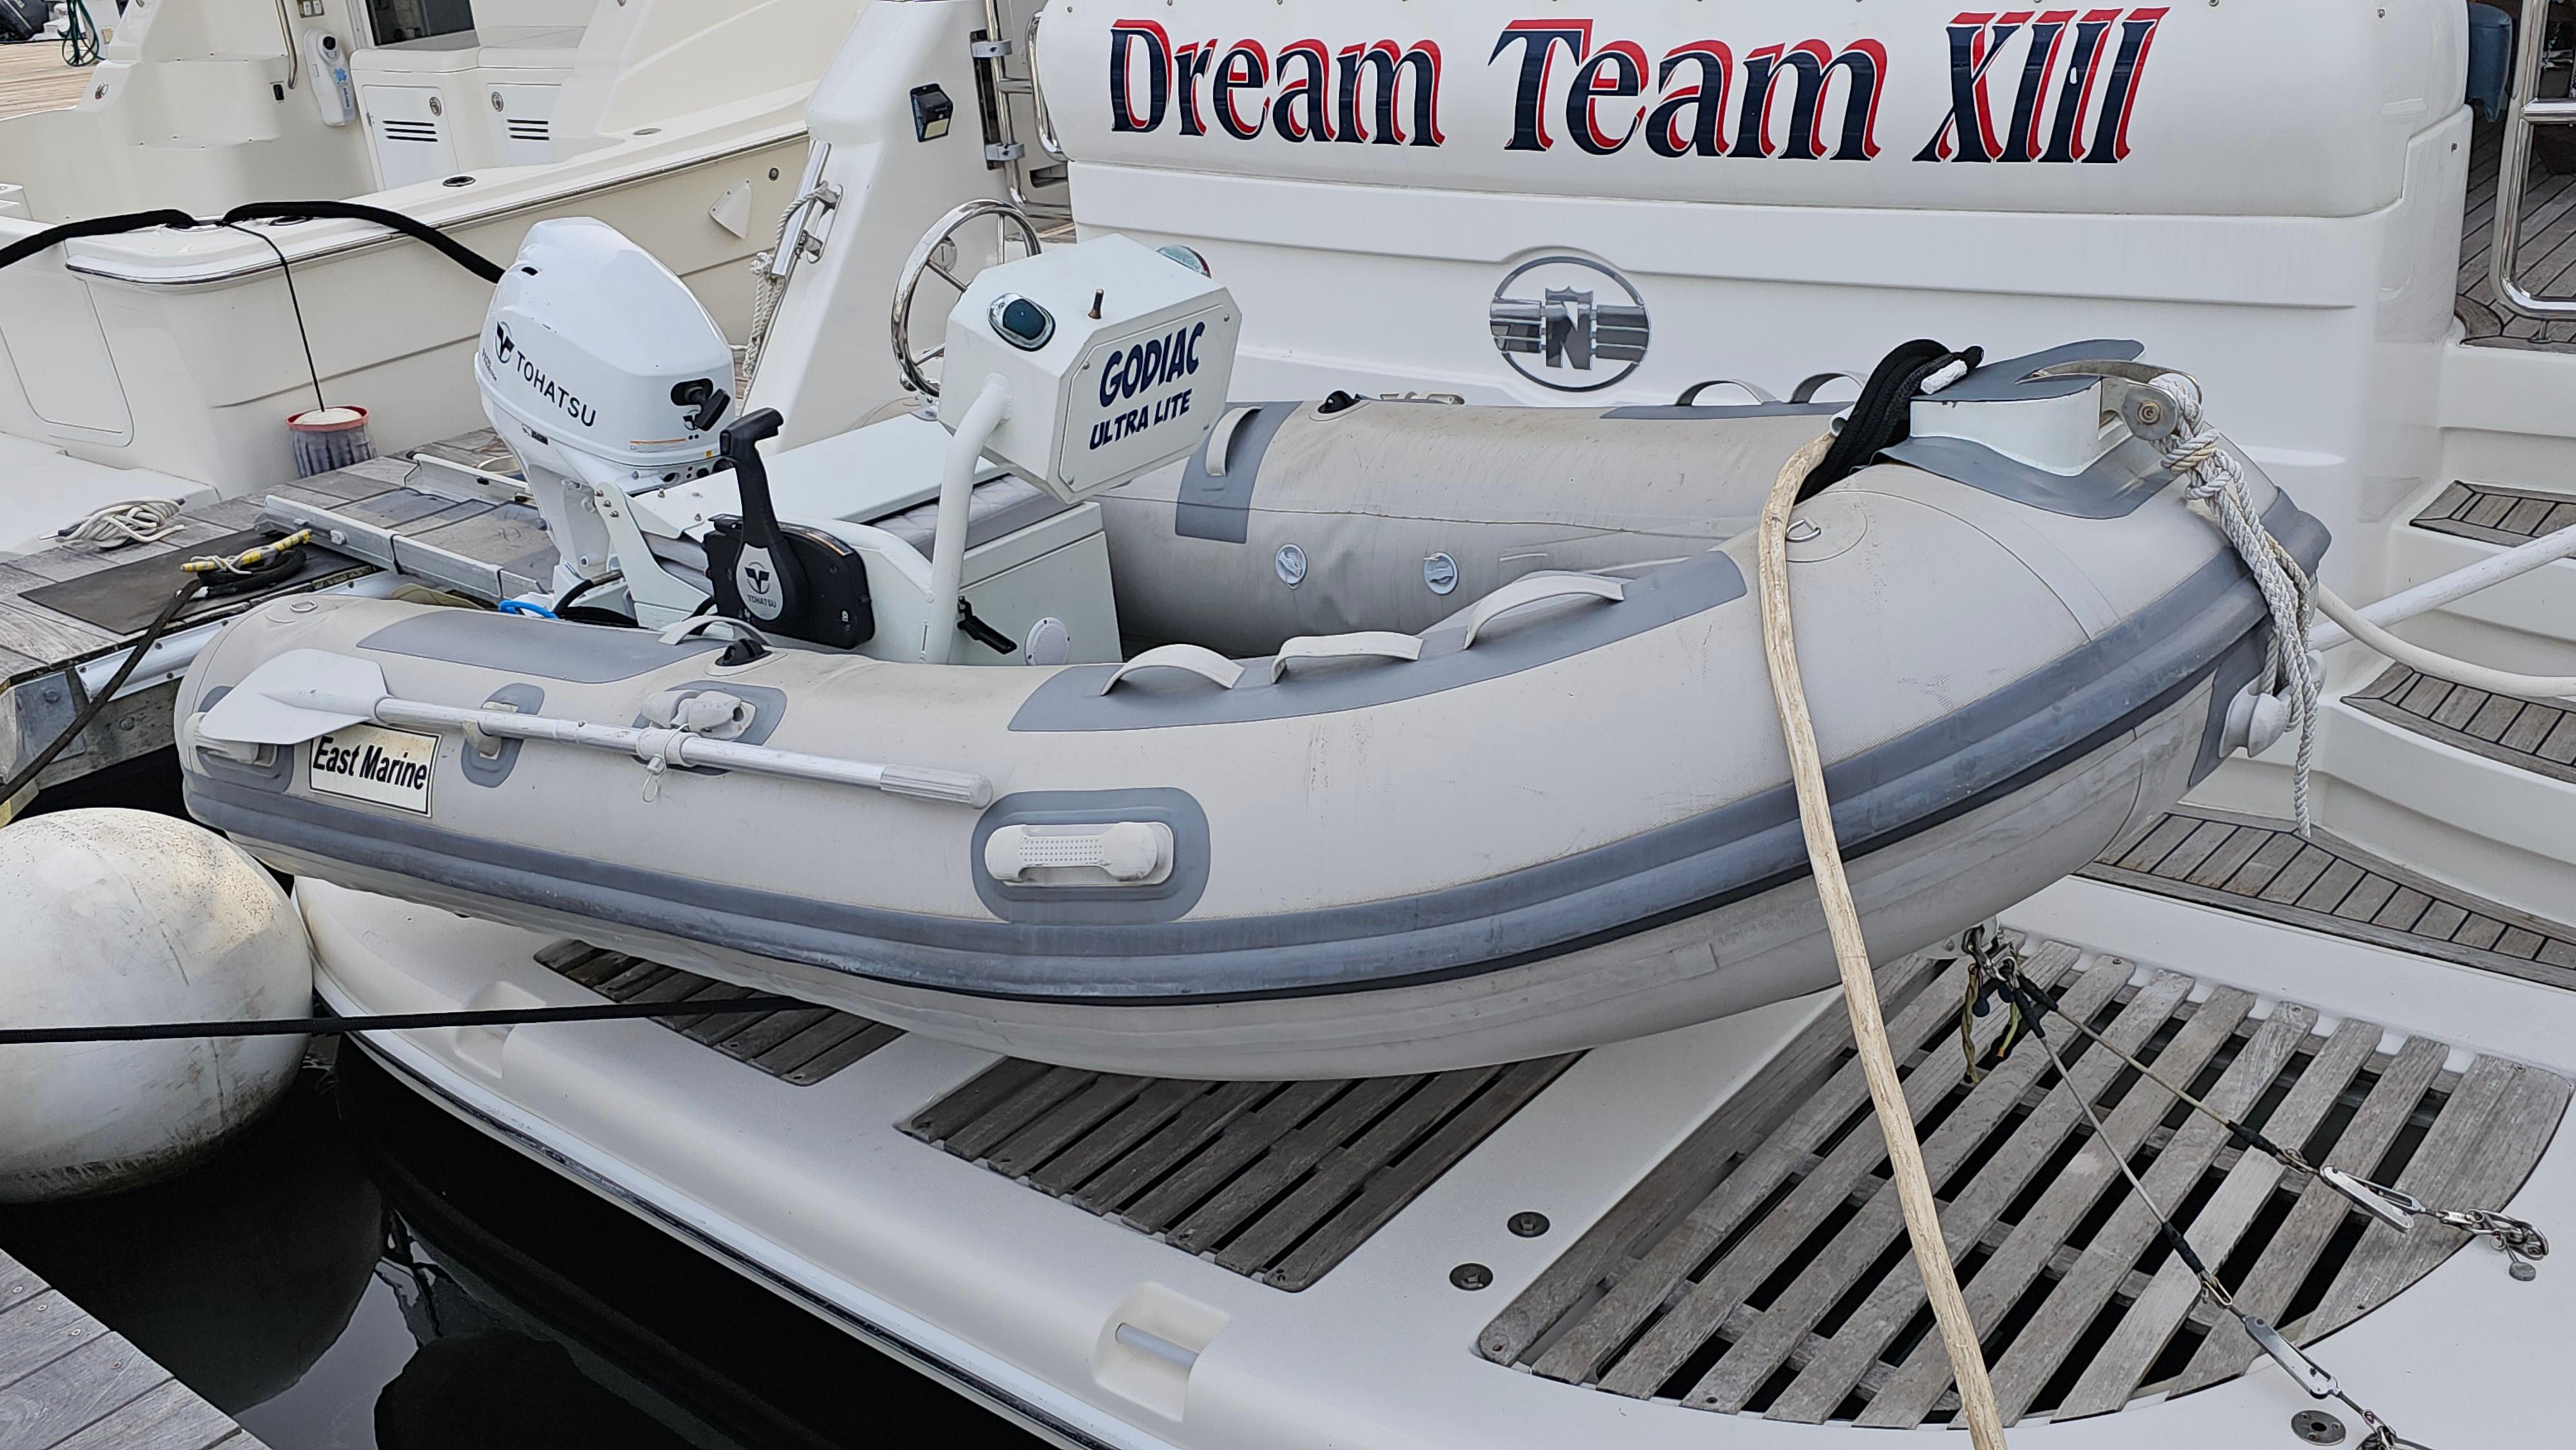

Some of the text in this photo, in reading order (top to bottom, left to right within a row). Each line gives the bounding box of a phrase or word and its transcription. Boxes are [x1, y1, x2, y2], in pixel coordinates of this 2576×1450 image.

[1110, 6, 2171, 164] Dream Team XIII
[516, 350, 597, 427] TOHATSU
[1099, 321, 1206, 408] GODIAC
[1089, 388, 1193, 450] ULTRA LITE
[746, 594, 777, 608] TOHATSU
[312, 735, 428, 790] East Marine
